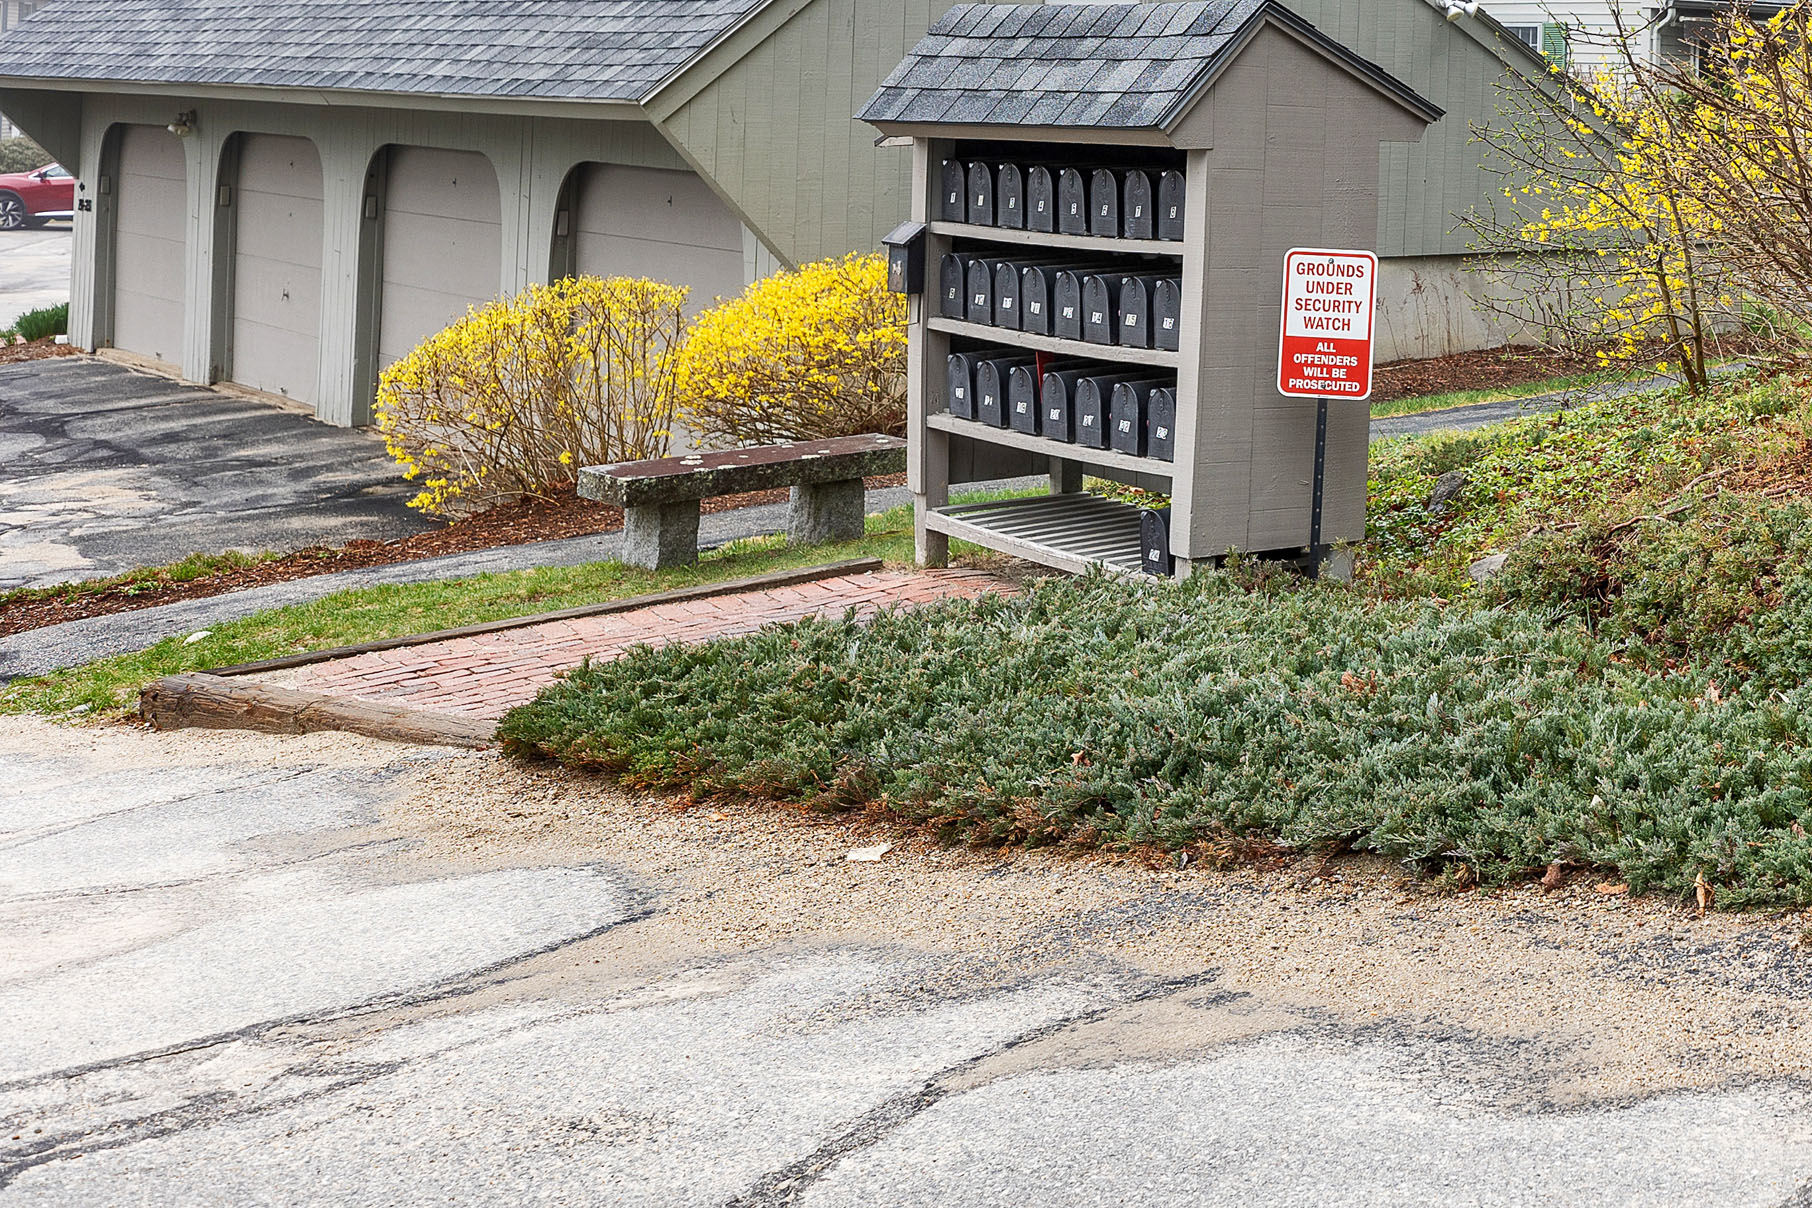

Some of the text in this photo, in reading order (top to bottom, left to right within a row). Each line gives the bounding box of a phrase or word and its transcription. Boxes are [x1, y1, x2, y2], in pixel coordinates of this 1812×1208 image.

[1296, 262, 1364, 278] GROUNDS
[1306, 280, 1353, 296] UNDER
[1294, 298, 1363, 314] SECURITY
[1303, 316, 1351, 332] WATCH
[1316, 342, 1336, 353] ALL
[1293, 353, 1358, 367] OFFENDERS
[1303, 367, 1347, 379] WILL BE
[1288, 378, 1360, 392] PROSECUTED
